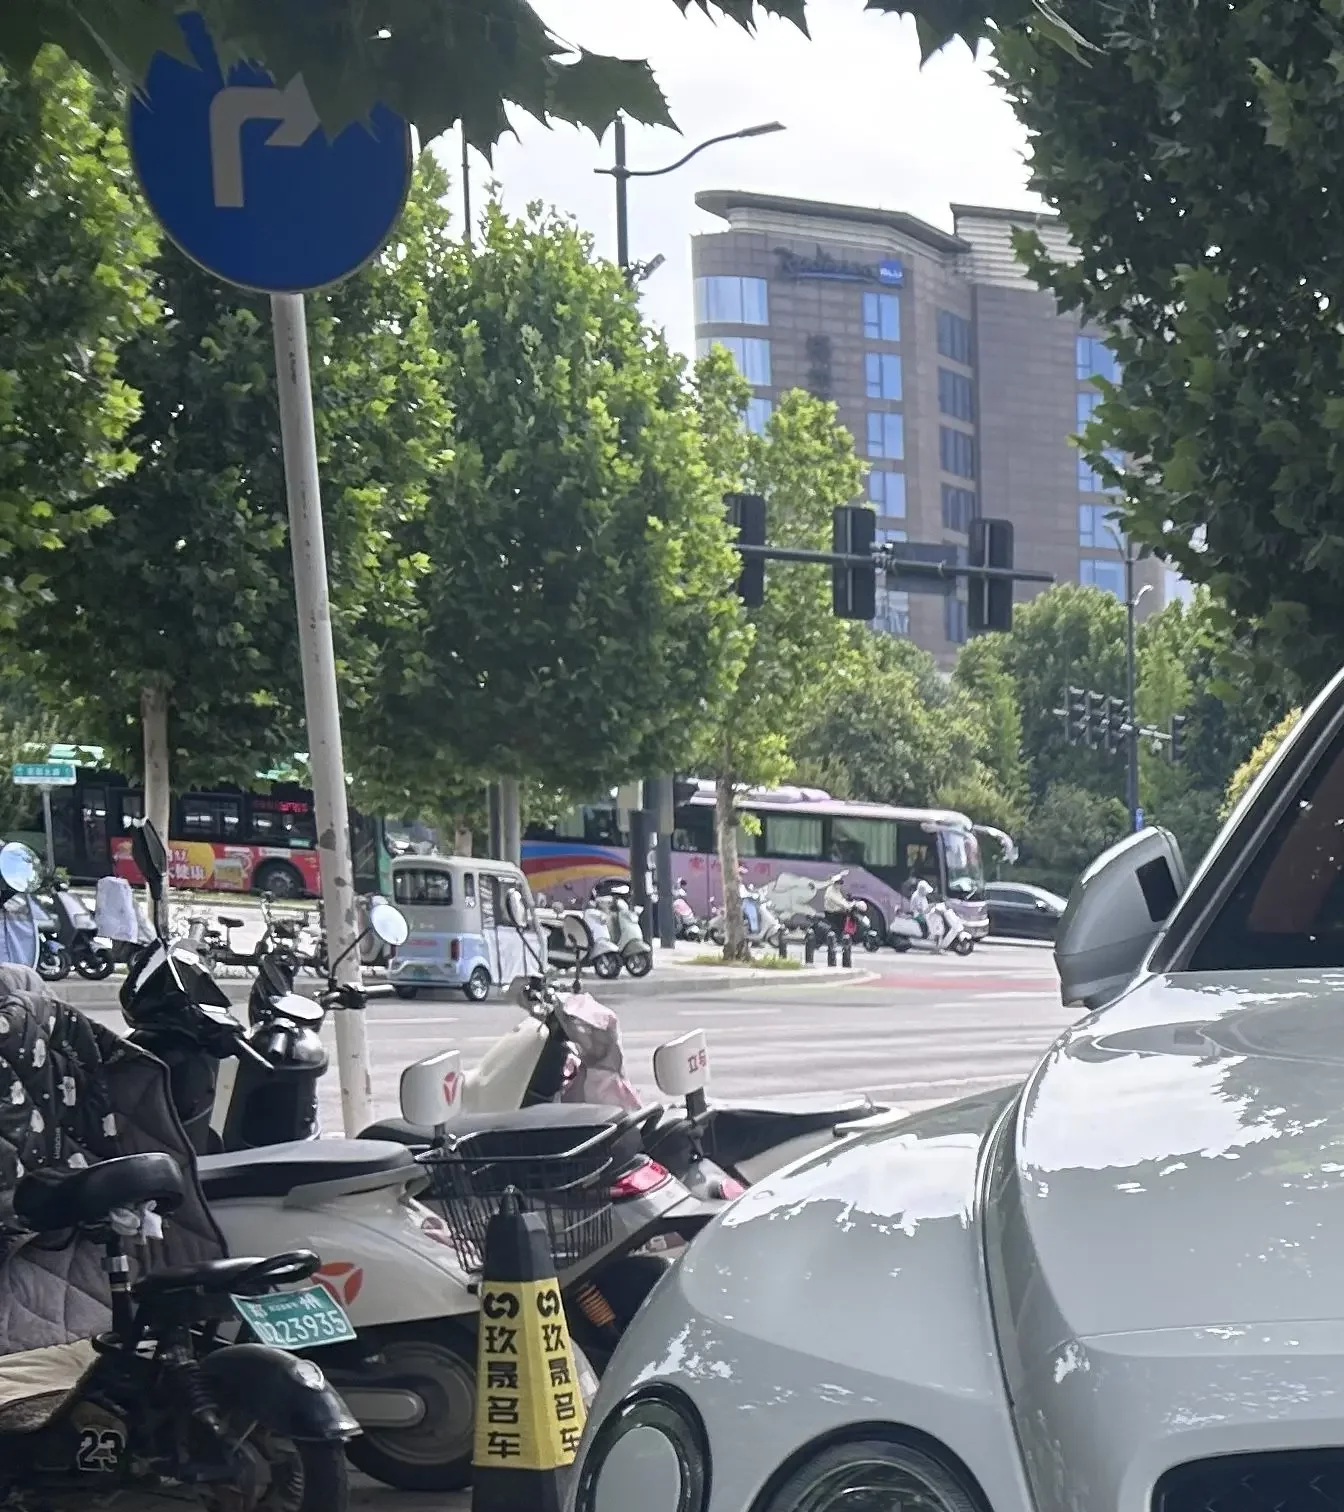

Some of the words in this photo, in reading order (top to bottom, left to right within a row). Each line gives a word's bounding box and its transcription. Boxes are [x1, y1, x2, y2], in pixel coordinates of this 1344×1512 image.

[485, 1325, 520, 1460] 玖晟名车
[76, 1427, 126, 1472] 23
